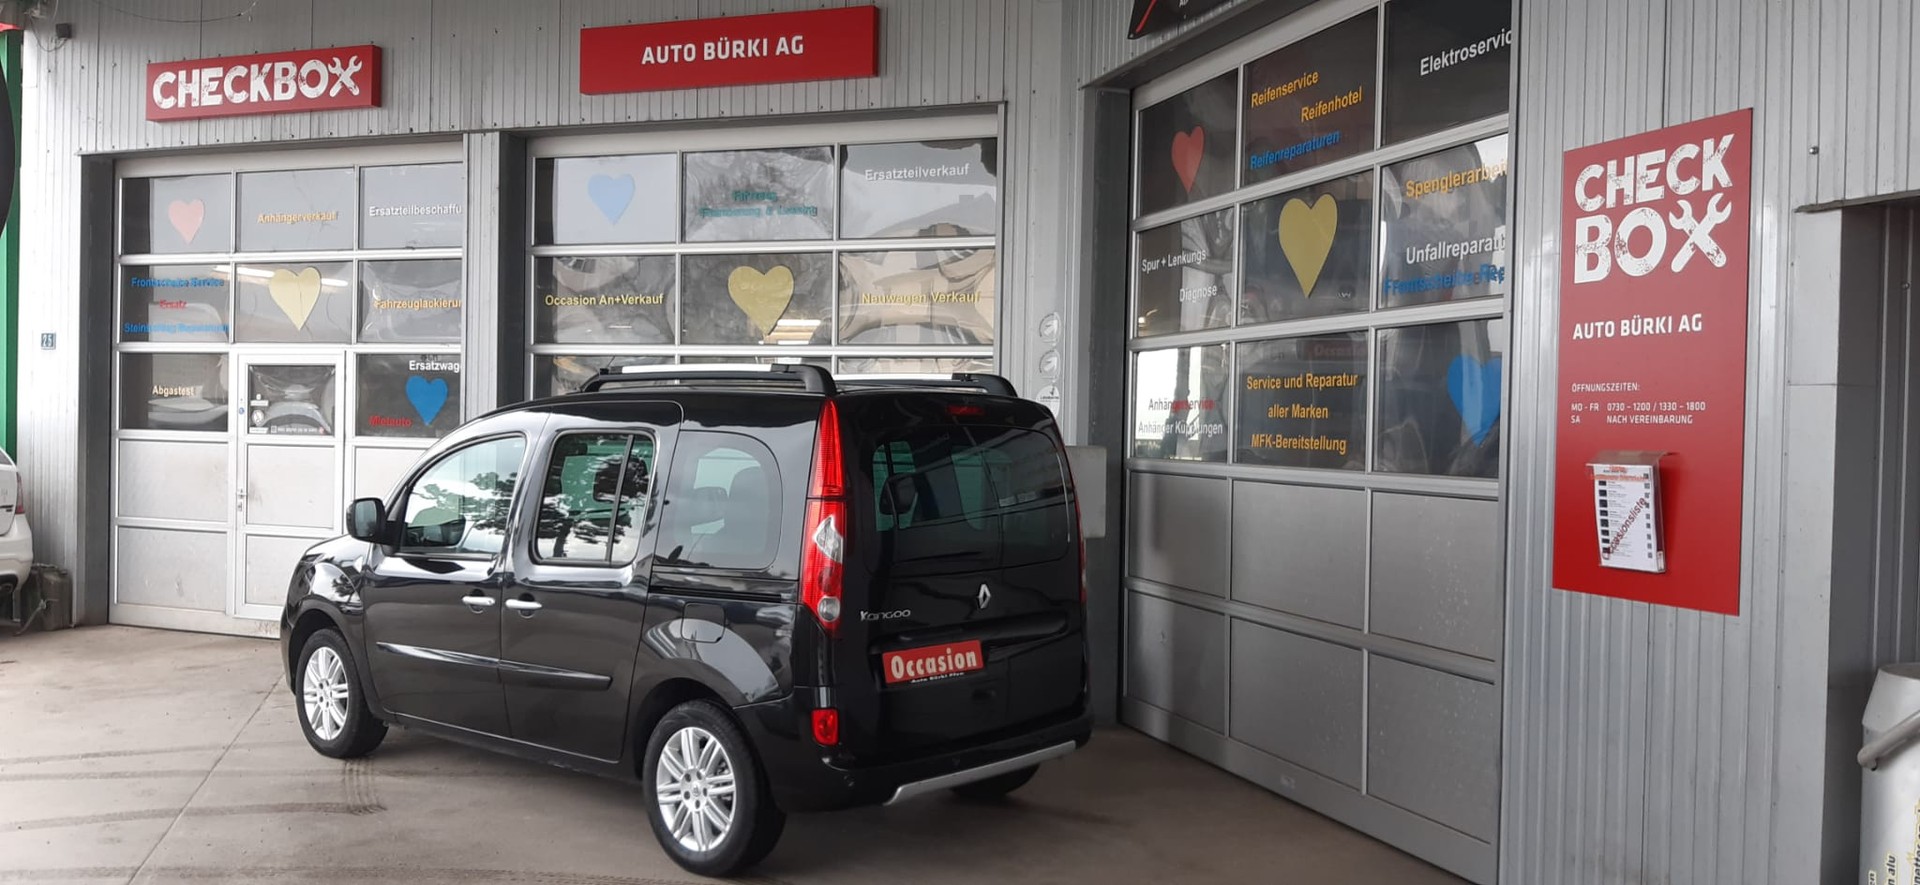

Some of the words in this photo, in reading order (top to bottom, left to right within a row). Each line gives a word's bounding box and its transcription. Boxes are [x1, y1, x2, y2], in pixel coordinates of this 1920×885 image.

[641, 43, 696, 65] AUTO
[703, 37, 768, 61] BÜRKI
[775, 35, 804, 55] AG
[152, 55, 363, 110] CHECKBOX
[1251, 69, 1319, 108] Reifenservice
[1301, 87, 1362, 123] Reifenhotel
[1251, 130, 1341, 170] Reifenreparaturen
[865, 163, 970, 182] Ersatzteilverkauf
[1574, 133, 1735, 212] CHECK
[257, 211, 338, 227] Anhängerverkauf
[1574, 192, 1732, 284] BOX
[1142, 258, 1160, 275] Spur
[1161, 257, 1167, 267] +
[1168, 249, 1207, 267] Lenkungs
[545, 294, 596, 306] Occasion
[599, 293, 664, 306] An+Verkauf
[862, 292, 927, 306] Neuwagen
[931, 290, 981, 304] Verkauf
[1179, 285, 1217, 303] Diagnose
[1573, 321, 1614, 340] AUTO
[1620, 314, 1672, 337] BÜRKI
[1678, 313, 1702, 333] AG
[152, 385, 195, 397] Abgastest
[1246, 375, 1281, 390] Service
[1284, 374, 1303, 388] und
[1306, 372, 1358, 391] Reparatur
[1571, 382, 1640, 393] ÖFFNUNGSZEITEN:
[1268, 404, 1289, 418] aller
[1291, 403, 1329, 419] Marken
[1571, 402, 1583, 412] MO
[1589, 402, 1600, 412] FR
[1607, 402, 1625, 411] 0730
[1633, 402, 1651, 411] 1200
[1659, 402, 1677, 411] 1330
[1686, 401, 1706, 411] 1800
[1571, 415, 1581, 424] SA
[1606, 415, 1628, 424] NACH
[1629, 415, 1693, 424] VEREINBARUNG
[1251, 433, 1347, 455] MFK-Bereitstellung
[891, 648, 977, 679] Occasion
[1886, 855, 1896, 877] alu
